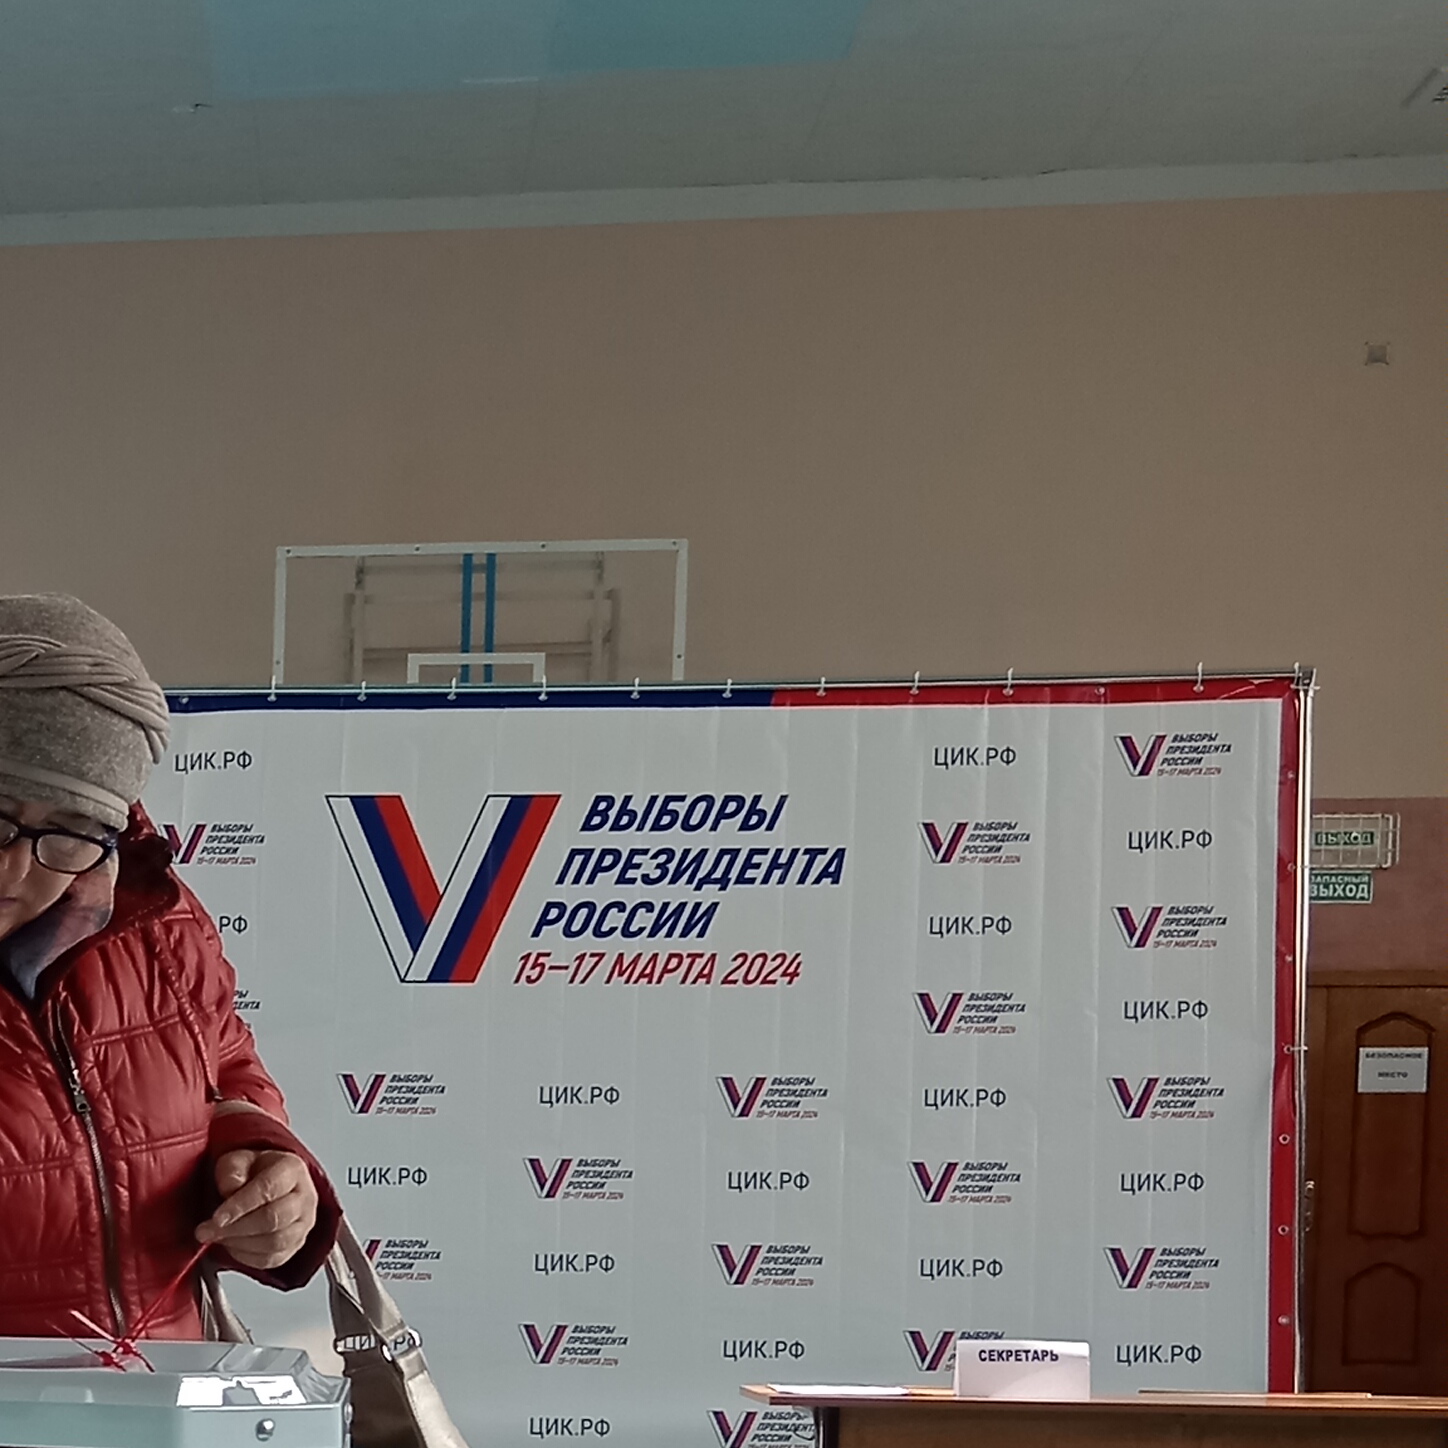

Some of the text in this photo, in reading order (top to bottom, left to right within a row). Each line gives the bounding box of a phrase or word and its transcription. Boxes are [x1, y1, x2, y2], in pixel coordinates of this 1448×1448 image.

[1171, 732, 1218, 743] ВЫБОРЫ
[174, 750, 253, 775] ЦИК.РФ
[934, 746, 1017, 771] ЦИК.РФ
[579, 794, 788, 832] ВЫБОРЫ
[210, 824, 253, 832] ВЫБОРЫ
[972, 821, 1017, 830] ВЫБОРЫ
[1128, 829, 1213, 854] ЦИК.РФ
[555, 847, 846, 891] ПРЕЗИДЕНТА
[530, 901, 720, 938] РОССИИ
[1167, 905, 1213, 915] ВЫБОРЫ
[929, 915, 1012, 939] ЦИК.РФ
[604, 952, 717, 985] МАРТА
[720, 952, 801, 985] 2024
[967, 992, 1013, 1001] ВЫБОРЫ
[1124, 999, 1209, 1024] ЦИК.РФ
[389, 1074, 433, 1082] ВЫБОРЫ
[770, 1077, 815, 1085] ВЫБОРЫ
[1164, 1076, 1210, 1086] ВЫБОРЫ
[539, 1085, 620, 1109] ЦИК.РФ
[924, 1087, 1007, 1111] ЦИК.РФ
[576, 1158, 620, 1167] ВЫБОРЫ
[962, 1162, 1008, 1170] ВЫБОРЫ
[348, 1166, 428, 1189] ЦИК.РФ
[727, 1171, 810, 1194] ЦИК.РФ
[1120, 1172, 1205, 1196] ЦИК.РФ
[385, 1239, 428, 1248] ВЫБОРЫ
[766, 1245, 810, 1254] ВЫБОРЫ
[1160, 1247, 1206, 1256] ВЫБОРЫ
[534, 1253, 615, 1276] ЦИК.РФ
[920, 1258, 1003, 1281] ЦИК.РФ
[571, 1325, 616, 1334] ВЫБОРЫ
[723, 1339, 805, 1362] ЦИК.РФ
[978, 1348, 1060, 1363] СЕКРЕТАРЬ
[1116, 1344, 1202, 1367] ЦИК.РФ
[529, 1417, 611, 1440] ЦИК.РФ
